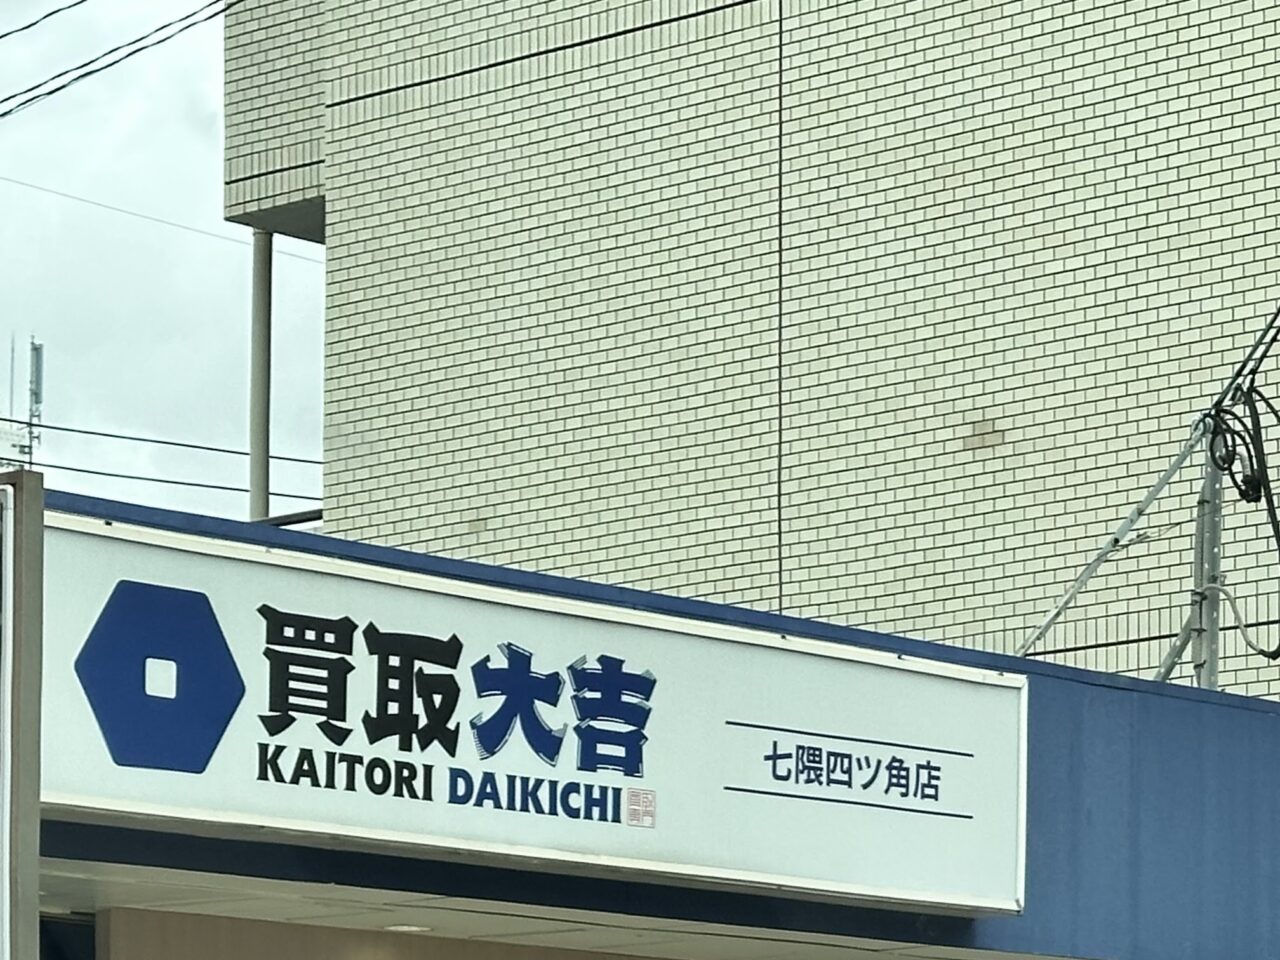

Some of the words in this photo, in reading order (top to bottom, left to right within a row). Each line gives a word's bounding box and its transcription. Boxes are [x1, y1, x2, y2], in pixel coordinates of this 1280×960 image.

[256, 603, 656, 778] 買取大吉
[256, 742, 434, 802] KAITORI
[447, 767, 622, 824] DAIKICHI
[763, 740, 942, 802] 七隈四ツ角店
